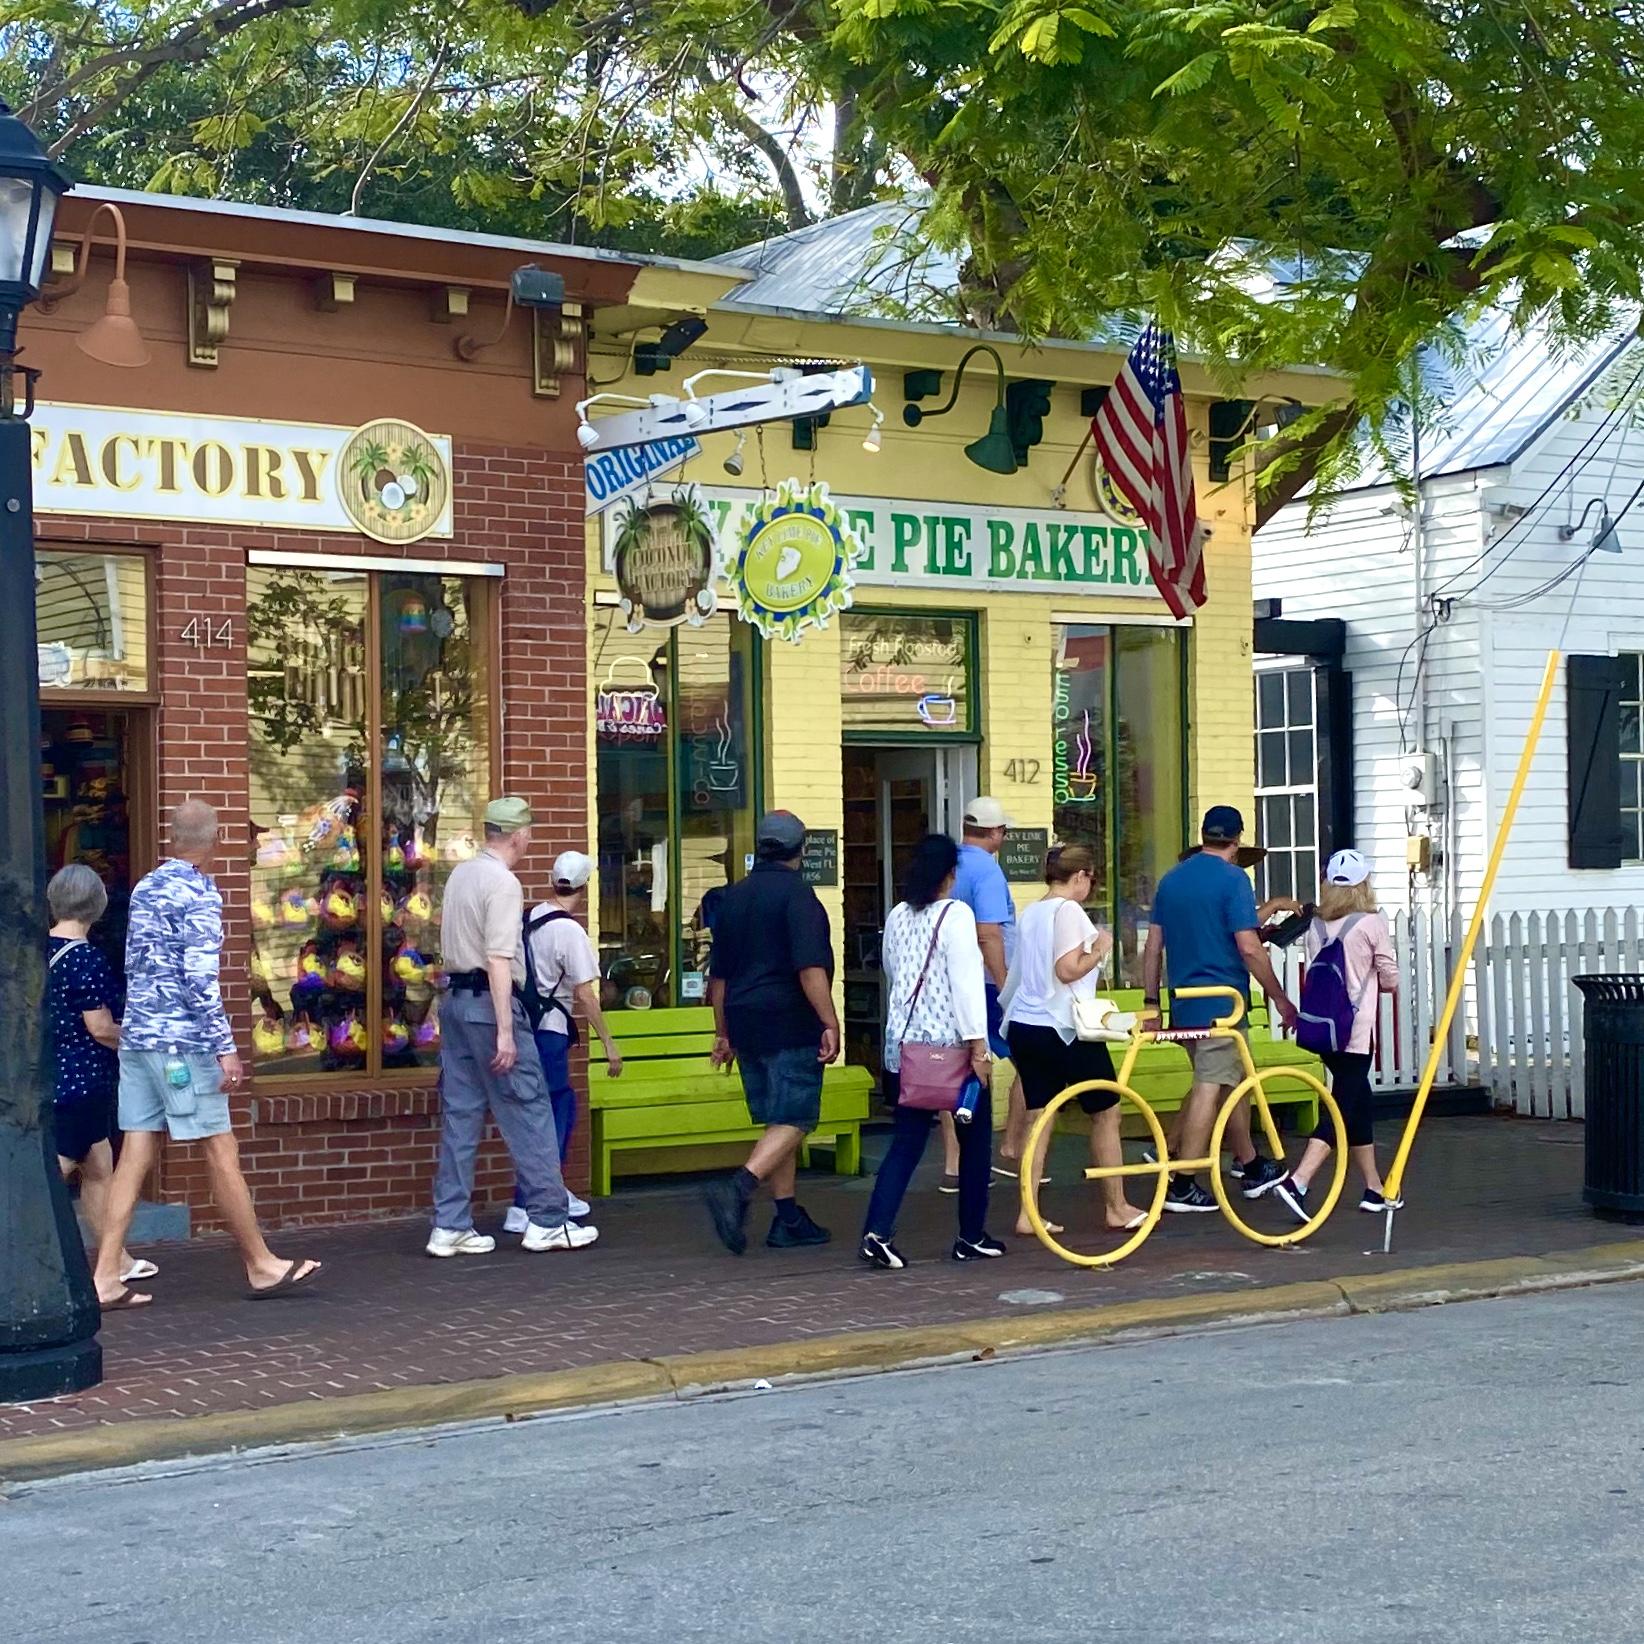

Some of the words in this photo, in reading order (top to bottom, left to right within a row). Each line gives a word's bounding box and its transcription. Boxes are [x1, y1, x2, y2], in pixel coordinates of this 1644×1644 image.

[891, 513, 973, 577] PIE
[181, 617, 235, 650] 414
[848, 635, 890, 656] Fresh
[844, 665, 926, 694] Coffee
[1003, 758, 1040, 785] 412
[1006, 855, 1041, 865] BAKERY
[1016, 843, 1031, 853] PIE
